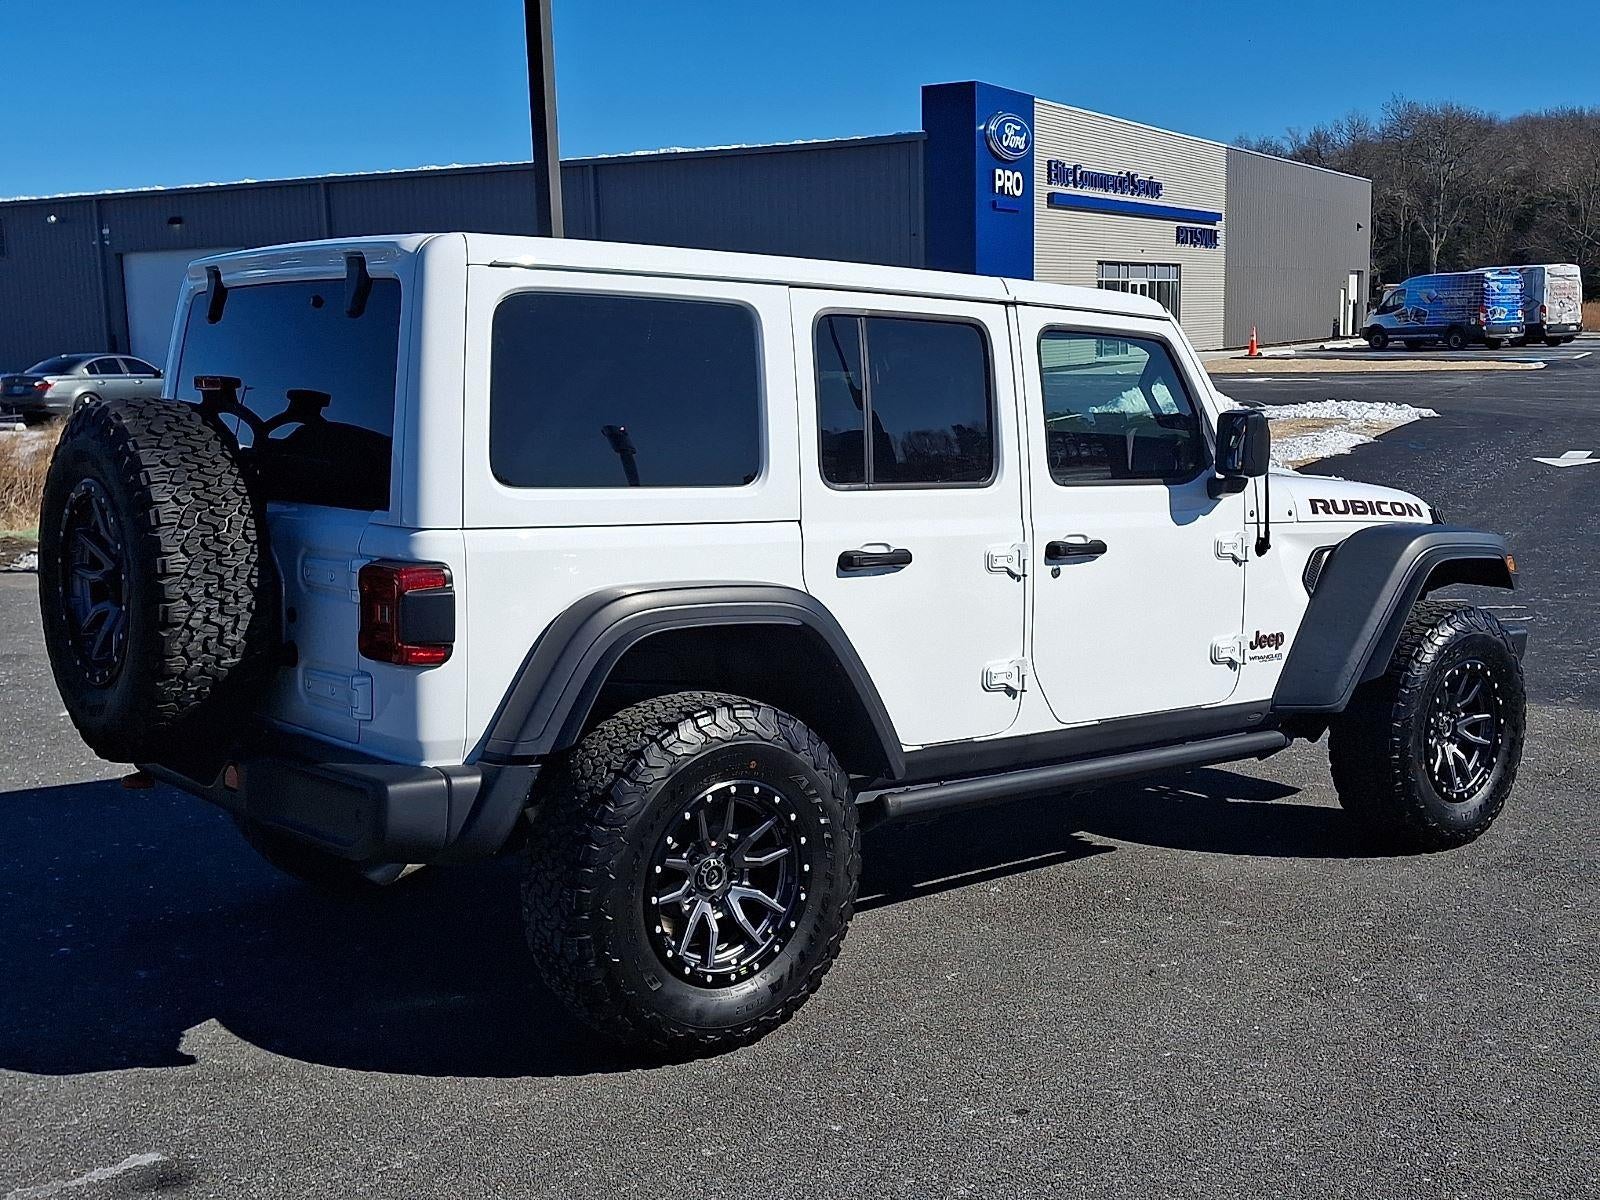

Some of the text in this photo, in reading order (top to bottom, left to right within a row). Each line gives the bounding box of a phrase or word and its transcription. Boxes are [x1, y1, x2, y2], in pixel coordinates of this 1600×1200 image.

[1003, 123, 1026, 149] Ford
[995, 168, 1023, 197] PRO
[1047, 160, 1163, 199] Elite Commercial Service
[1176, 226, 1220, 248] PITTSVILLE
[1308, 499, 1424, 517] RUBICON
[1249, 630, 1285, 650] Jeep
